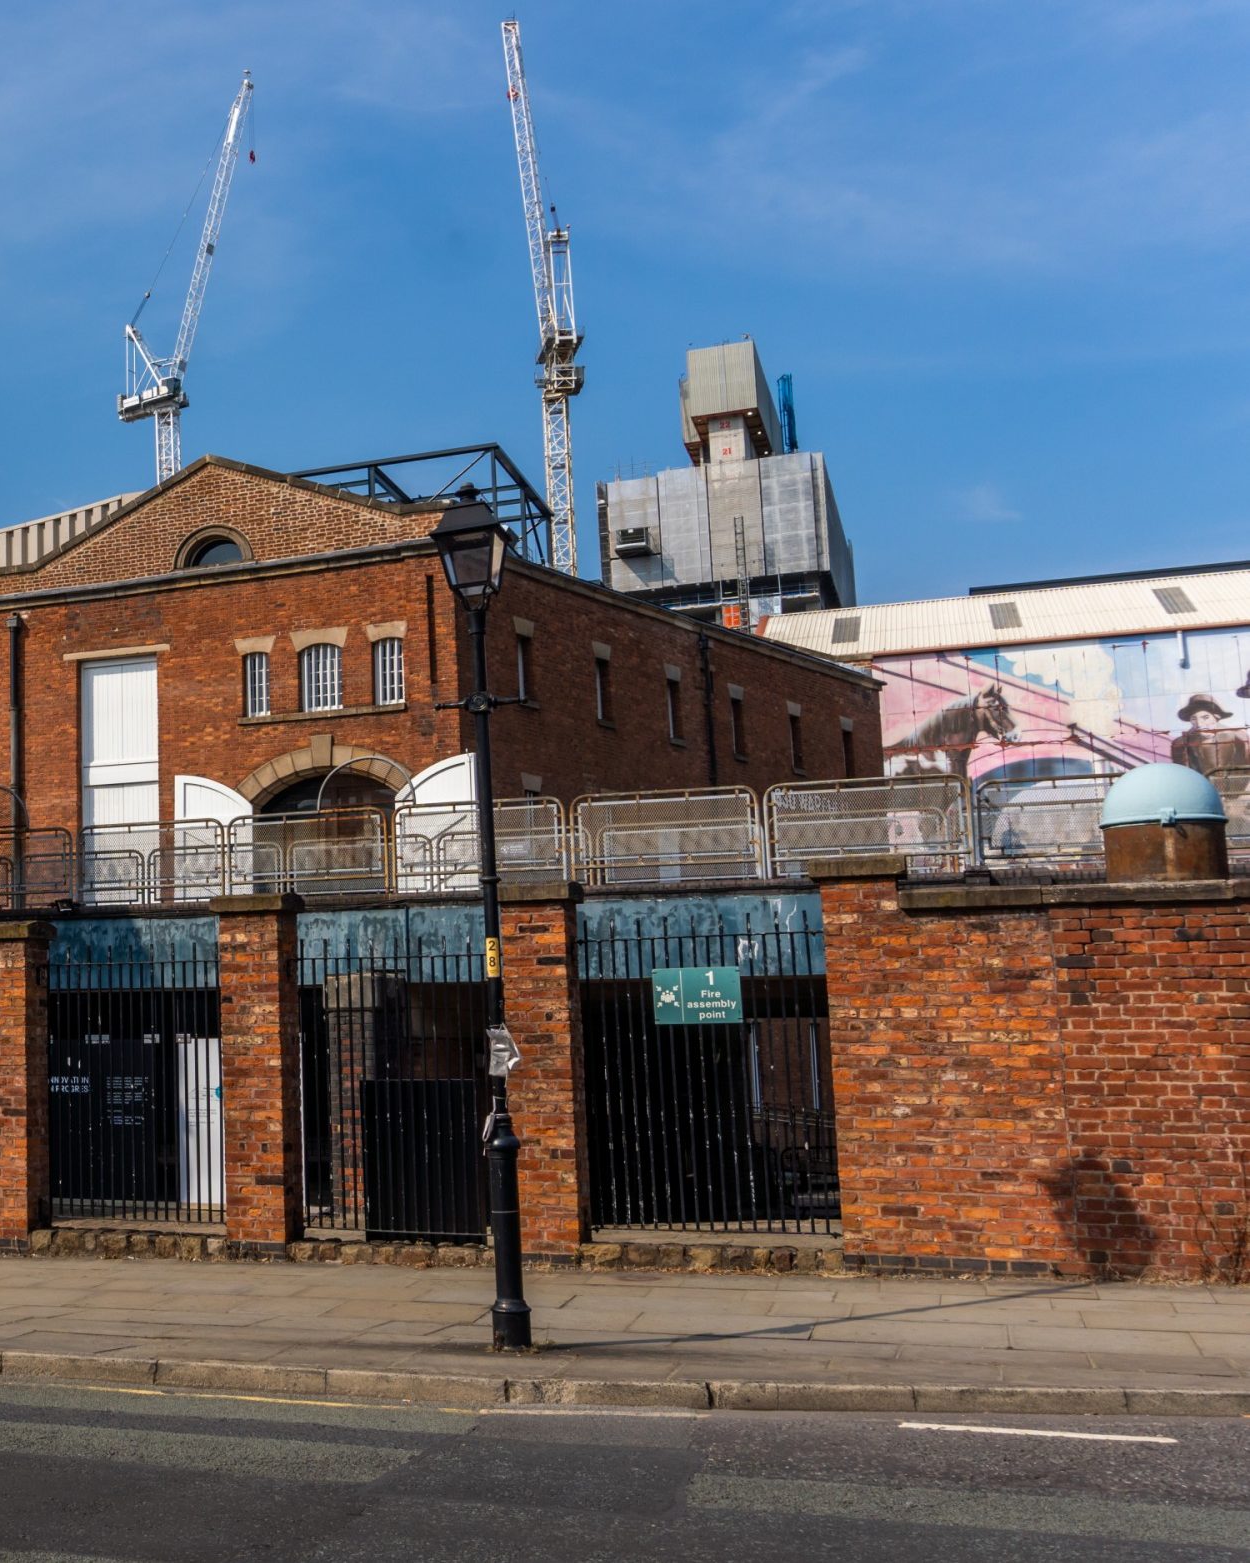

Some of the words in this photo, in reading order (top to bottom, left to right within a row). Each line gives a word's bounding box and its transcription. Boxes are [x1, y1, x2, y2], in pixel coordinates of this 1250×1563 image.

[704, 970, 715, 986] 1
[700, 989, 722, 998] Fire
[686, 999, 737, 1009] assembly
[699, 1011, 726, 1021] point
